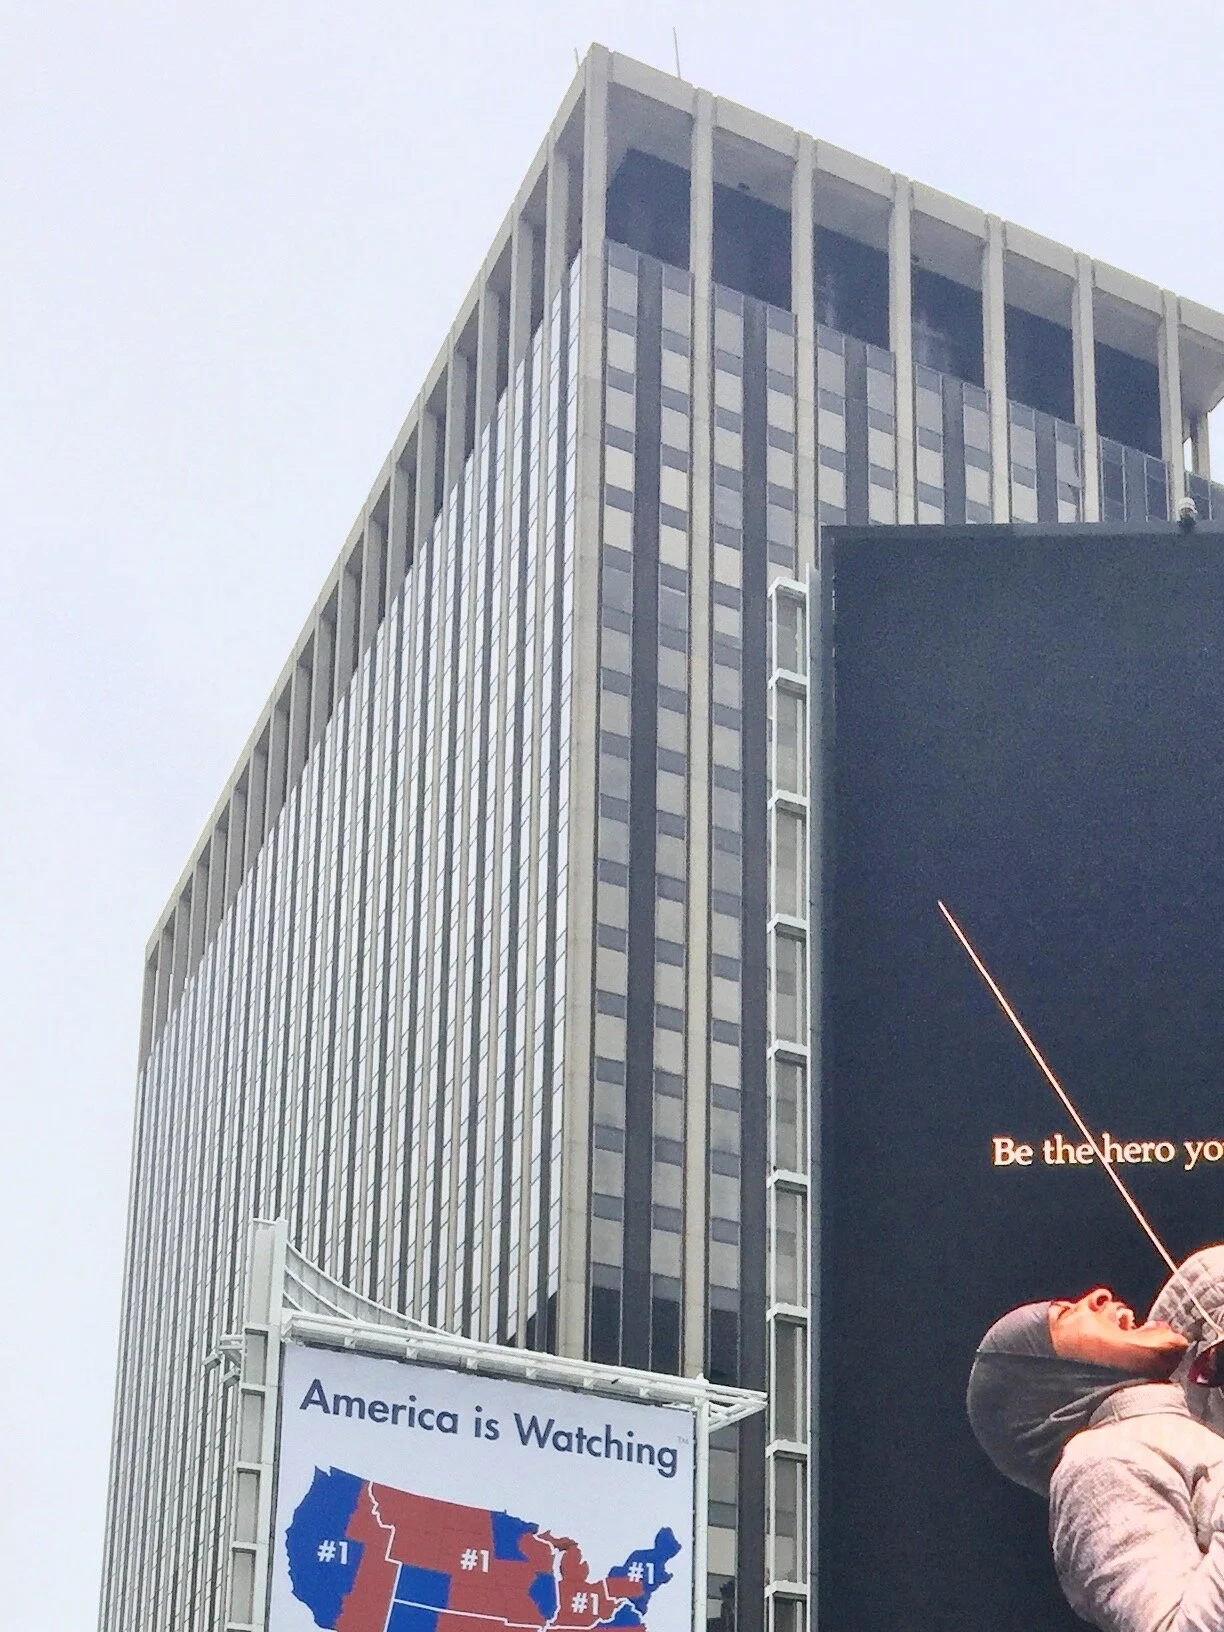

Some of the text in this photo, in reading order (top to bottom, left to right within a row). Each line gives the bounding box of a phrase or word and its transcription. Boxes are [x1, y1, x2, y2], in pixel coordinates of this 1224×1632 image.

[993, 1137, 1033, 1166] Be
[1042, 1134, 1093, 1165] the
[1102, 1132, 1175, 1164] hero
[300, 1378, 459, 1435] America
[474, 1405, 500, 1441] is
[513, 1412, 679, 1478] Watching
[317, 1540, 348, 1565] #1
[460, 1548, 490, 1573] #1
[627, 1561, 655, 1585] #1
[571, 1591, 599, 1616] #1
